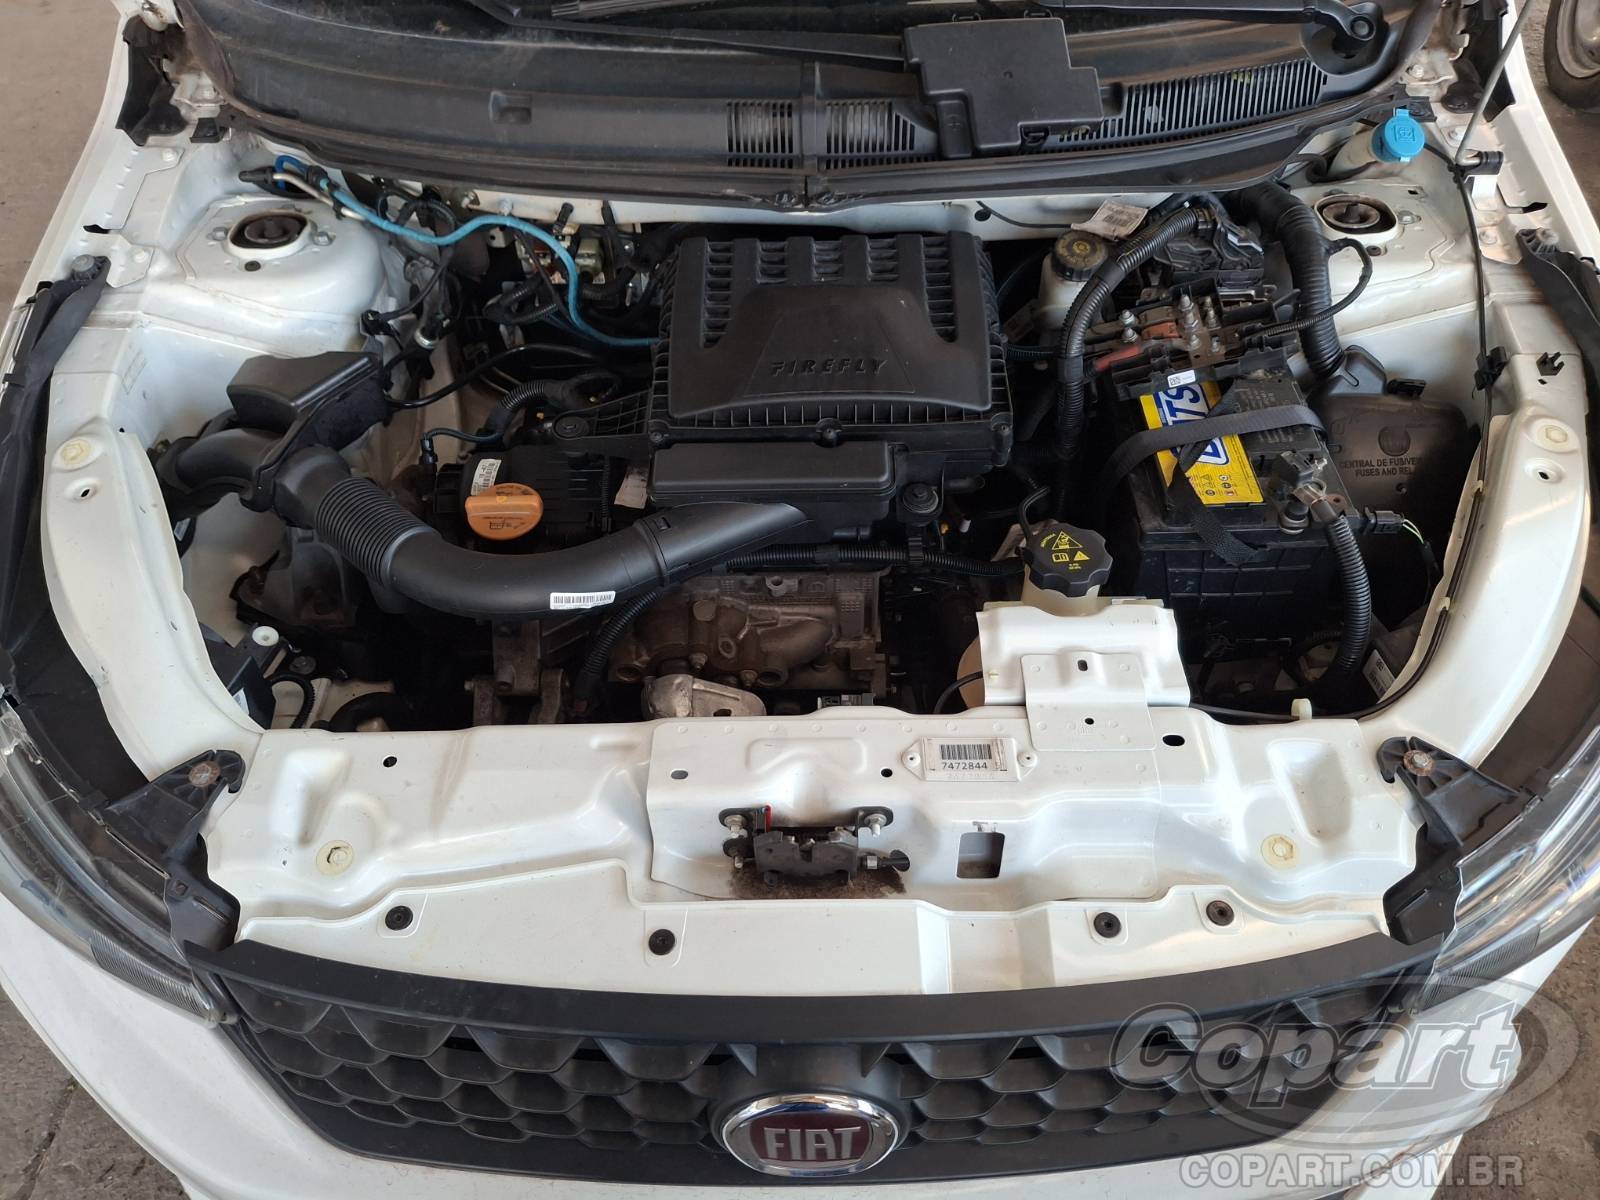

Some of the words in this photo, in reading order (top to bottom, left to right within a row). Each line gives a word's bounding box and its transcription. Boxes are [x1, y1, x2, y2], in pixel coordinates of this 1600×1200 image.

[771, 359, 888, 377] FIREFLY
[1376, 458, 1388, 467] DE
[1355, 468, 1380, 477] FUSES
[1382, 468, 1397, 476] AND
[941, 761, 988, 770] 7472844
[763, 1126, 862, 1161] FIAT
